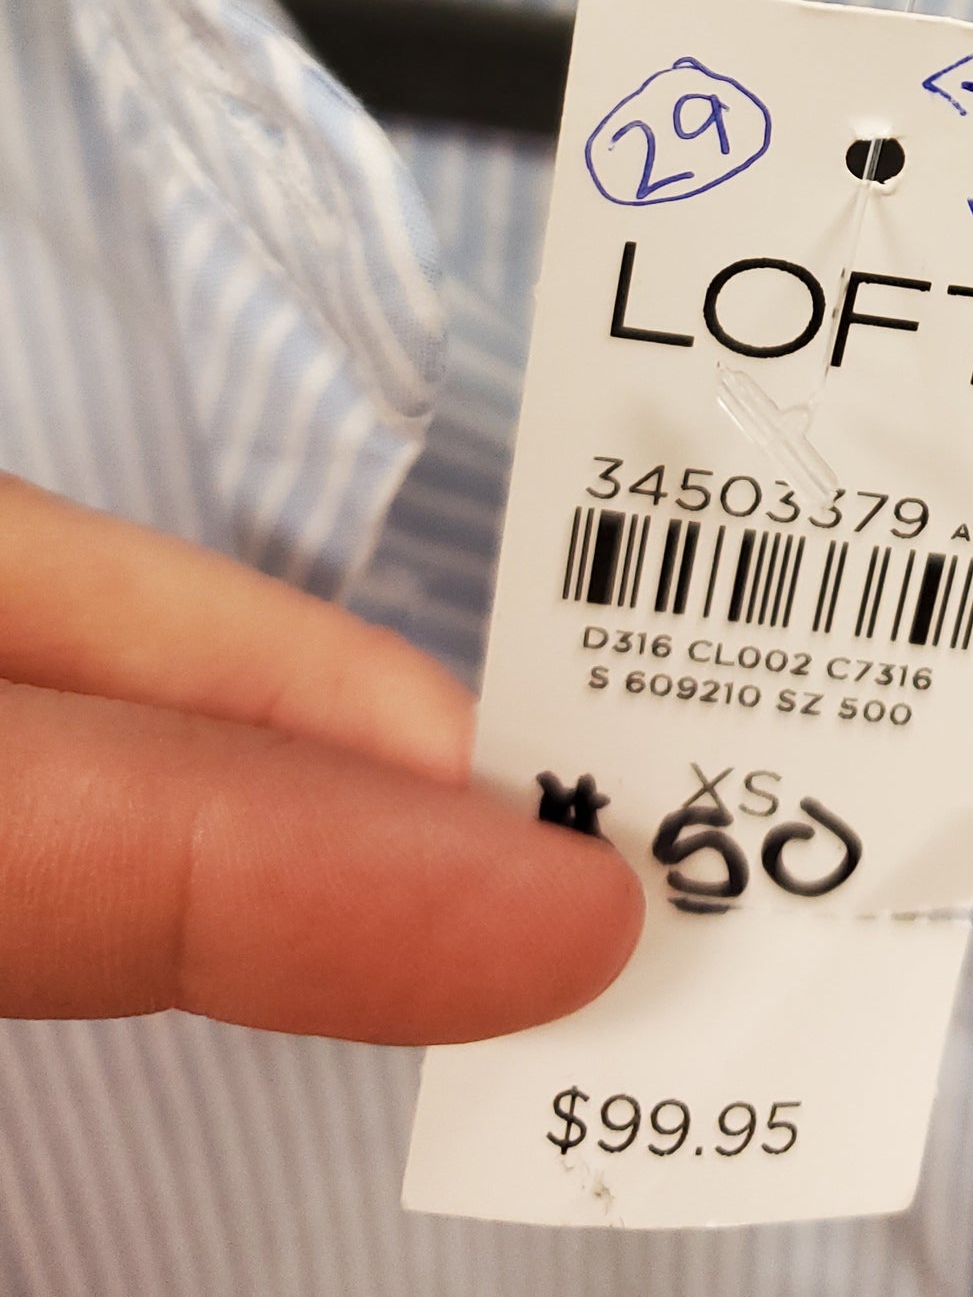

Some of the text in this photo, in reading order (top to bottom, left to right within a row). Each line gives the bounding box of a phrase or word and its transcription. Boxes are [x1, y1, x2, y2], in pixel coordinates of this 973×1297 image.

[606, 93, 731, 201] 29
[585, 456, 930, 540] 34503379
[582, 625, 673, 660] D316
[827, 657, 934, 692] C7316
[588, 666, 913, 727] S 609210 SZ 500
[682, 762, 783, 818] XS
[546, 1085, 802, 1157] $99.95
